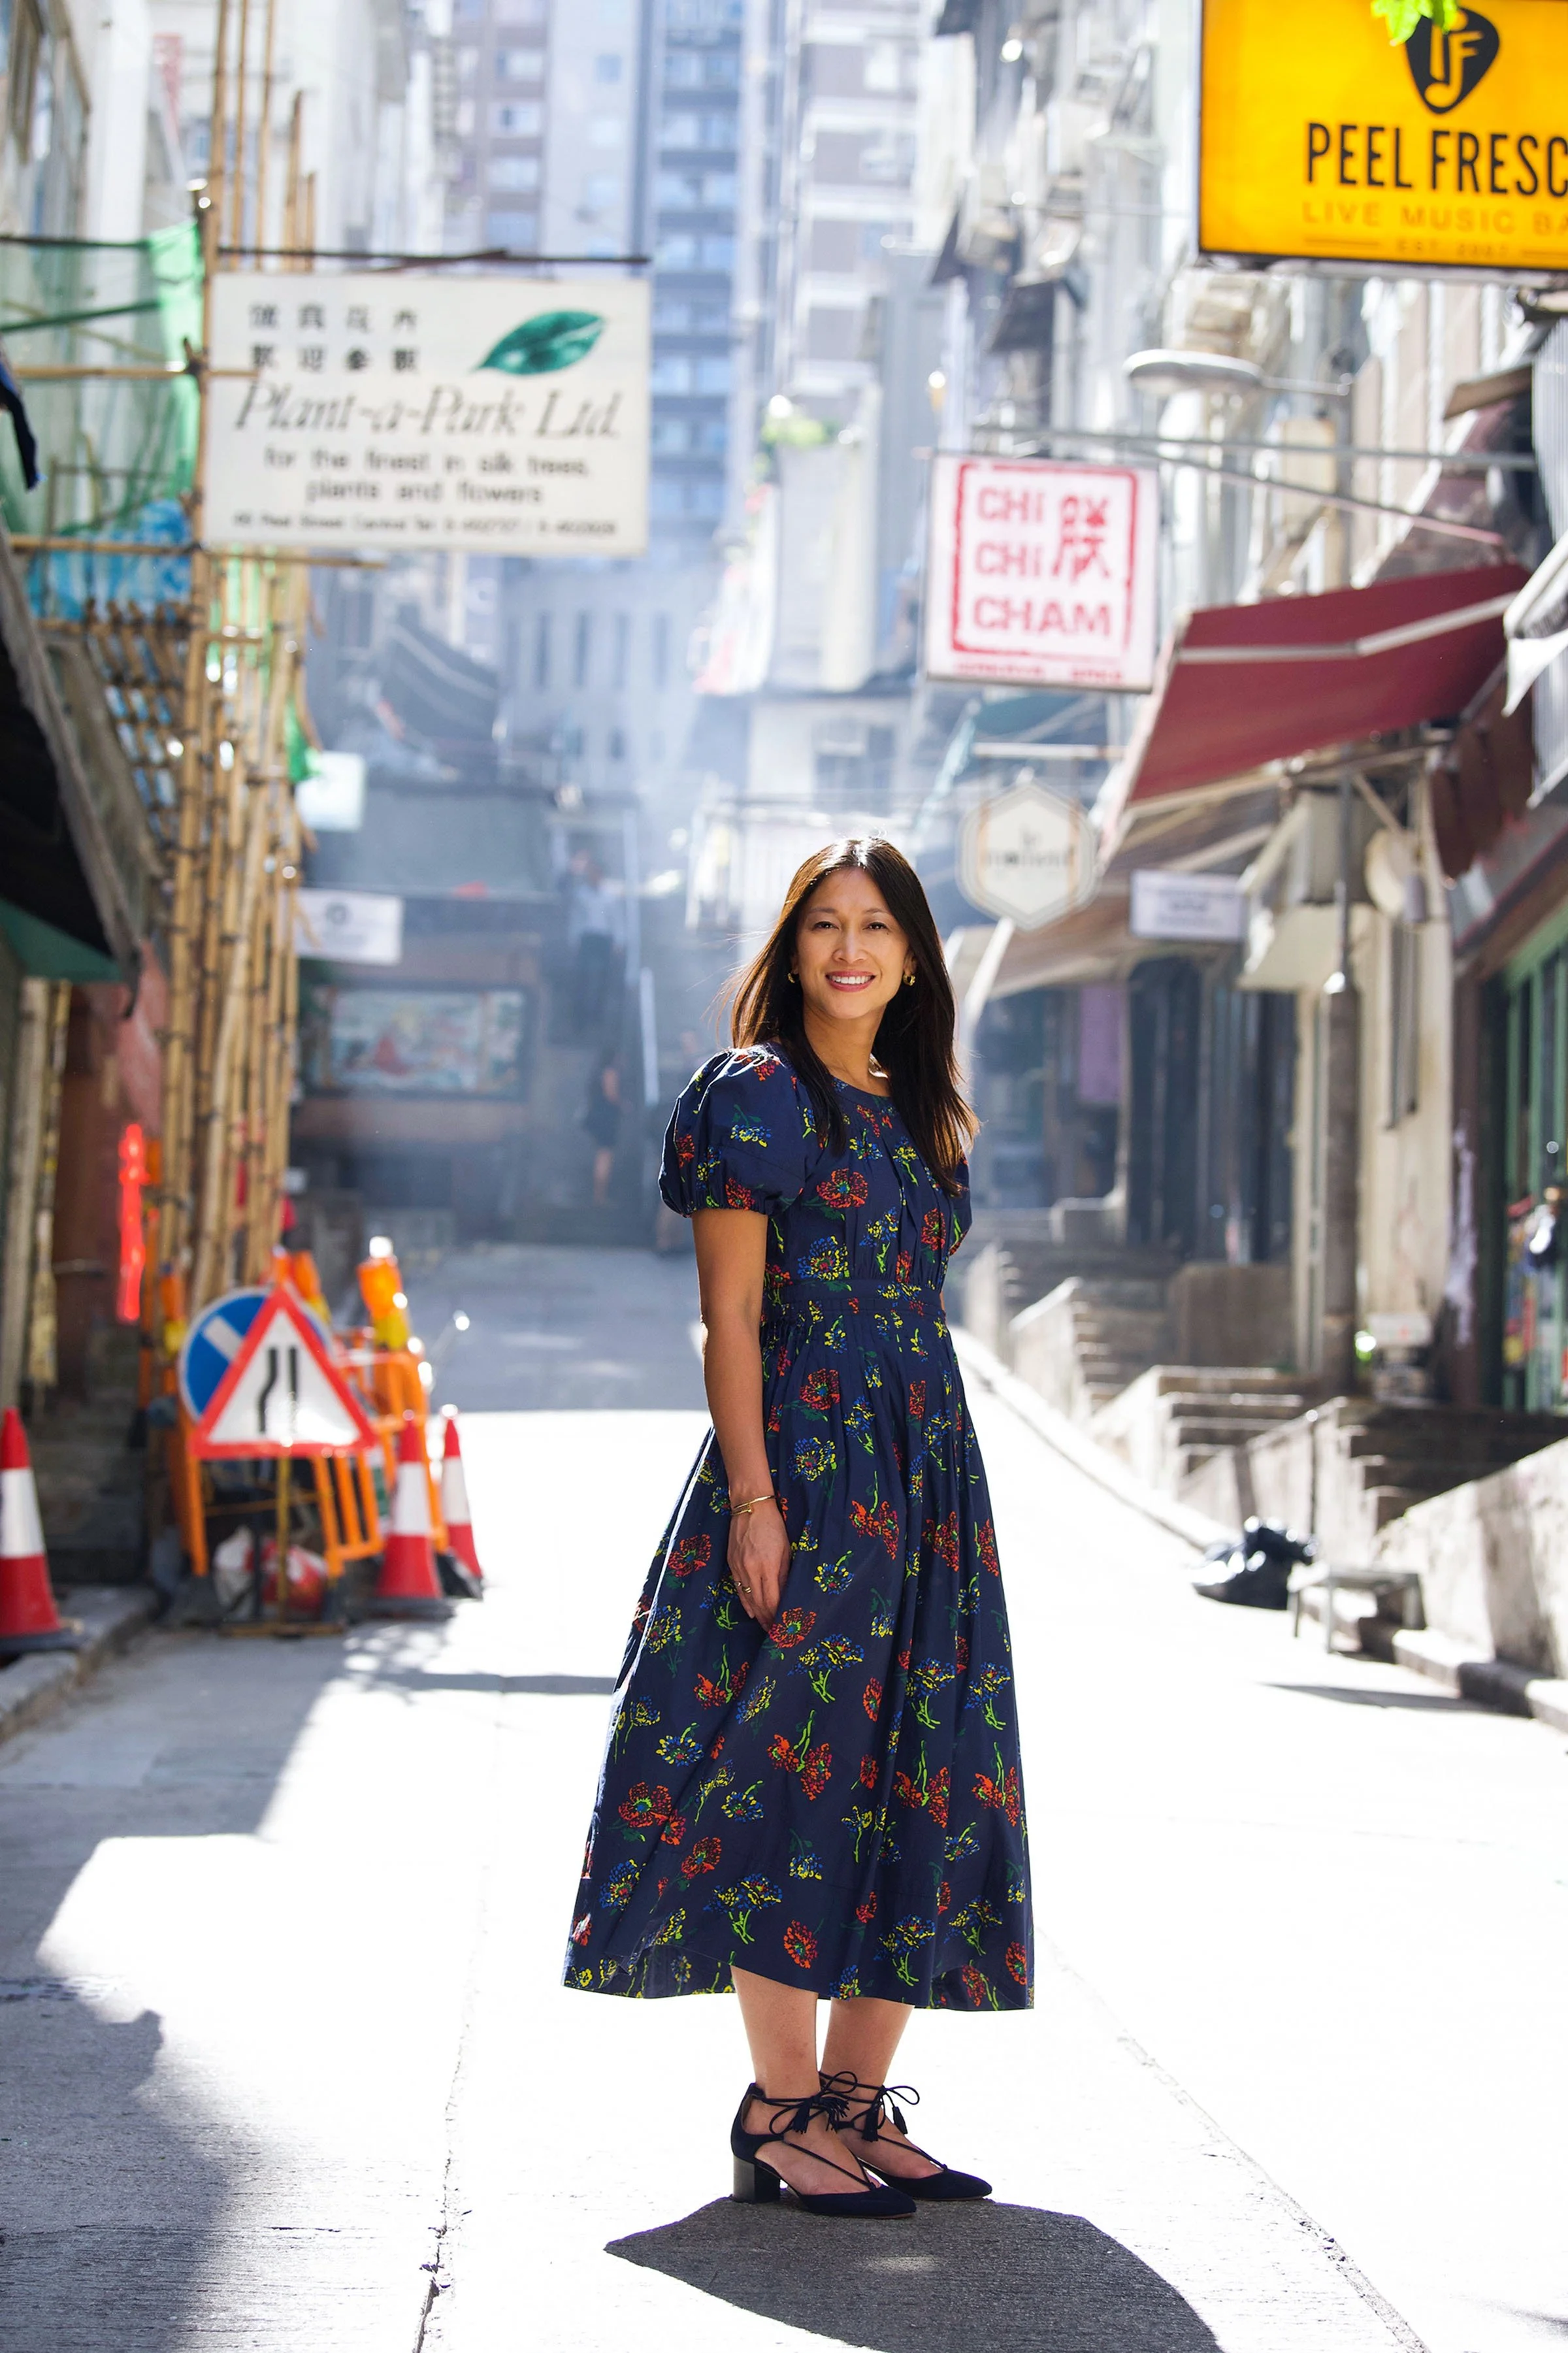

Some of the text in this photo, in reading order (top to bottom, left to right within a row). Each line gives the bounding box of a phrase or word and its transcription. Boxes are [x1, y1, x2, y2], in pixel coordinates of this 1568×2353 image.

[1307, 122, 1568, 197] PEEL FRESC
[1302, 201, 1380, 227] LIVE
[1399, 206, 1517, 235] MUSIC
[231, 380, 525, 438] Plant-a-Park
[265, 444, 296, 467] for
[312, 448, 350, 469] the
[365, 447, 429, 471] finest
[444, 454, 465, 472] in
[480, 450, 513, 474] silk
[306, 478, 543, 506] plants and flowers
[977, 486, 1045, 523] CHI
[974, 540, 1042, 578] CHI
[972, 595, 1112, 637] CHAM
